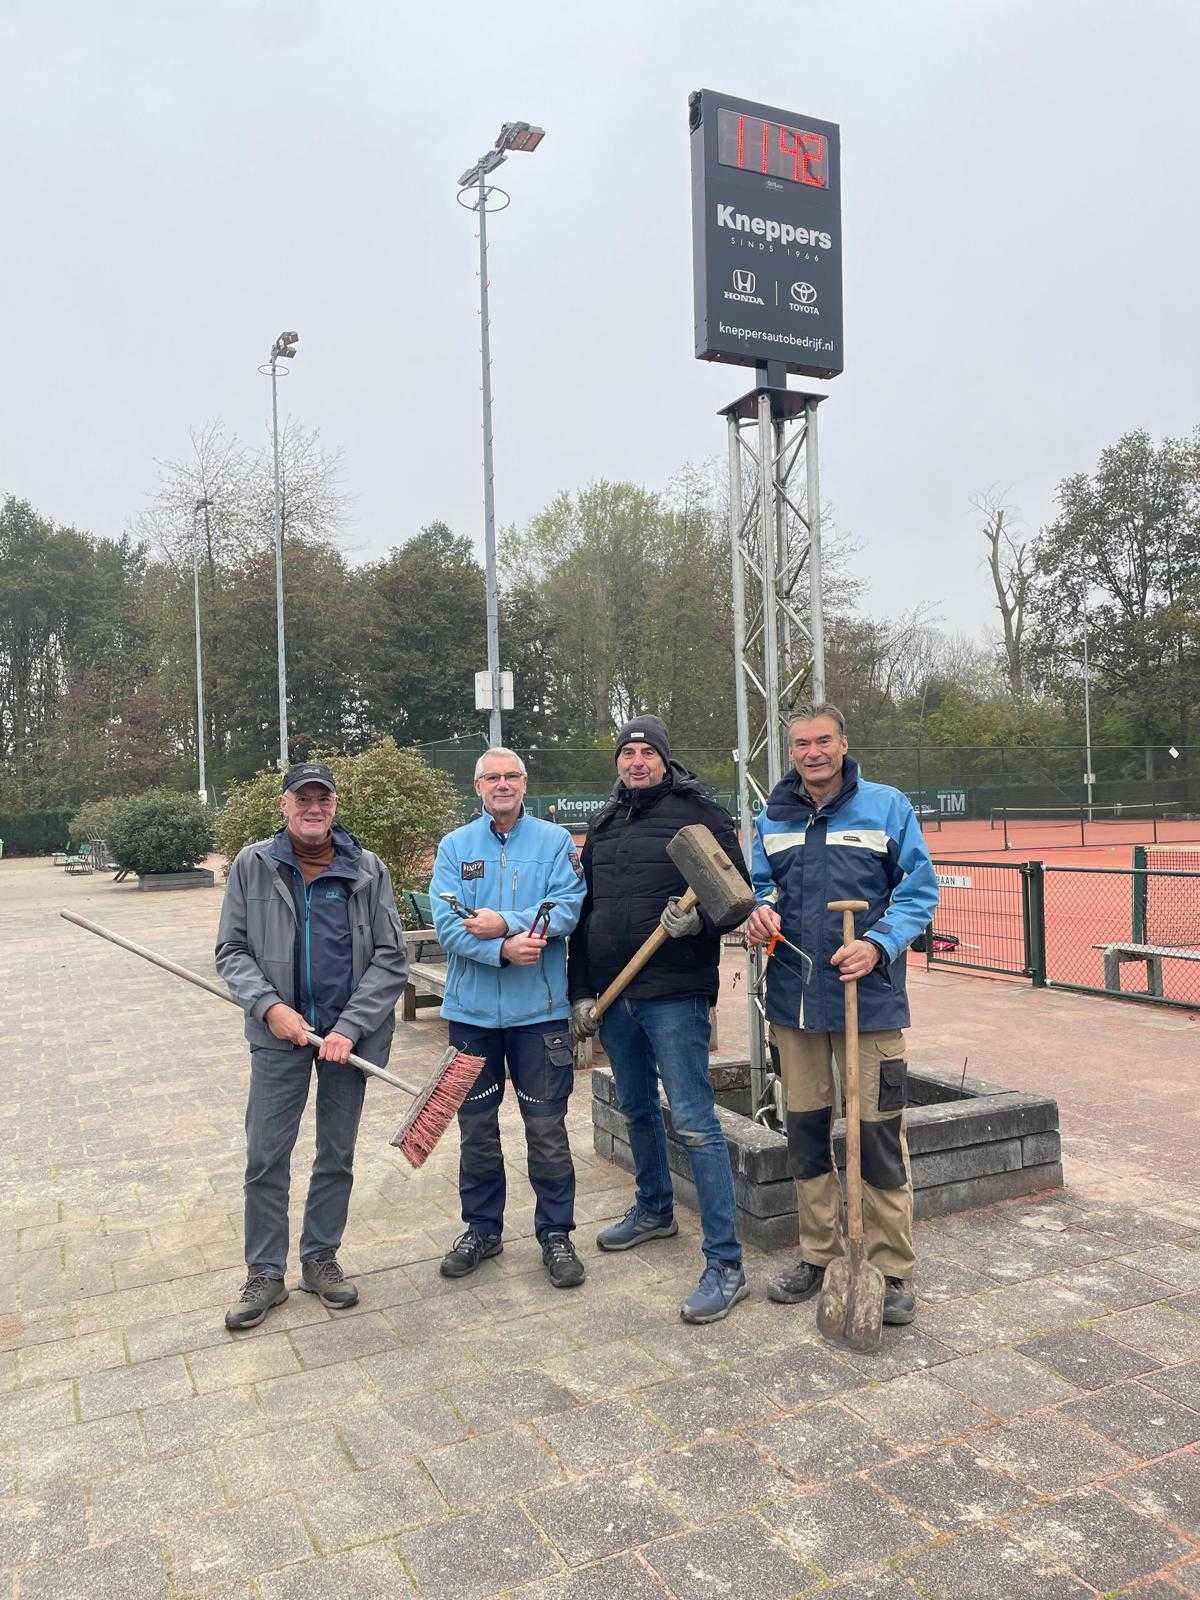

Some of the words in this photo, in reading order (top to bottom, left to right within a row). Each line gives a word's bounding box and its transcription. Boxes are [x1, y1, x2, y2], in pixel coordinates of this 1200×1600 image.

[716, 203, 833, 250] Kneppers
[730, 237, 775, 252] SINDS
[787, 248, 820, 263] 1966
[723, 291, 766, 306] HONDA
[788, 302, 820, 316] TOYOTA
[718, 321, 835, 352] kneppersautobedrijf.nl
